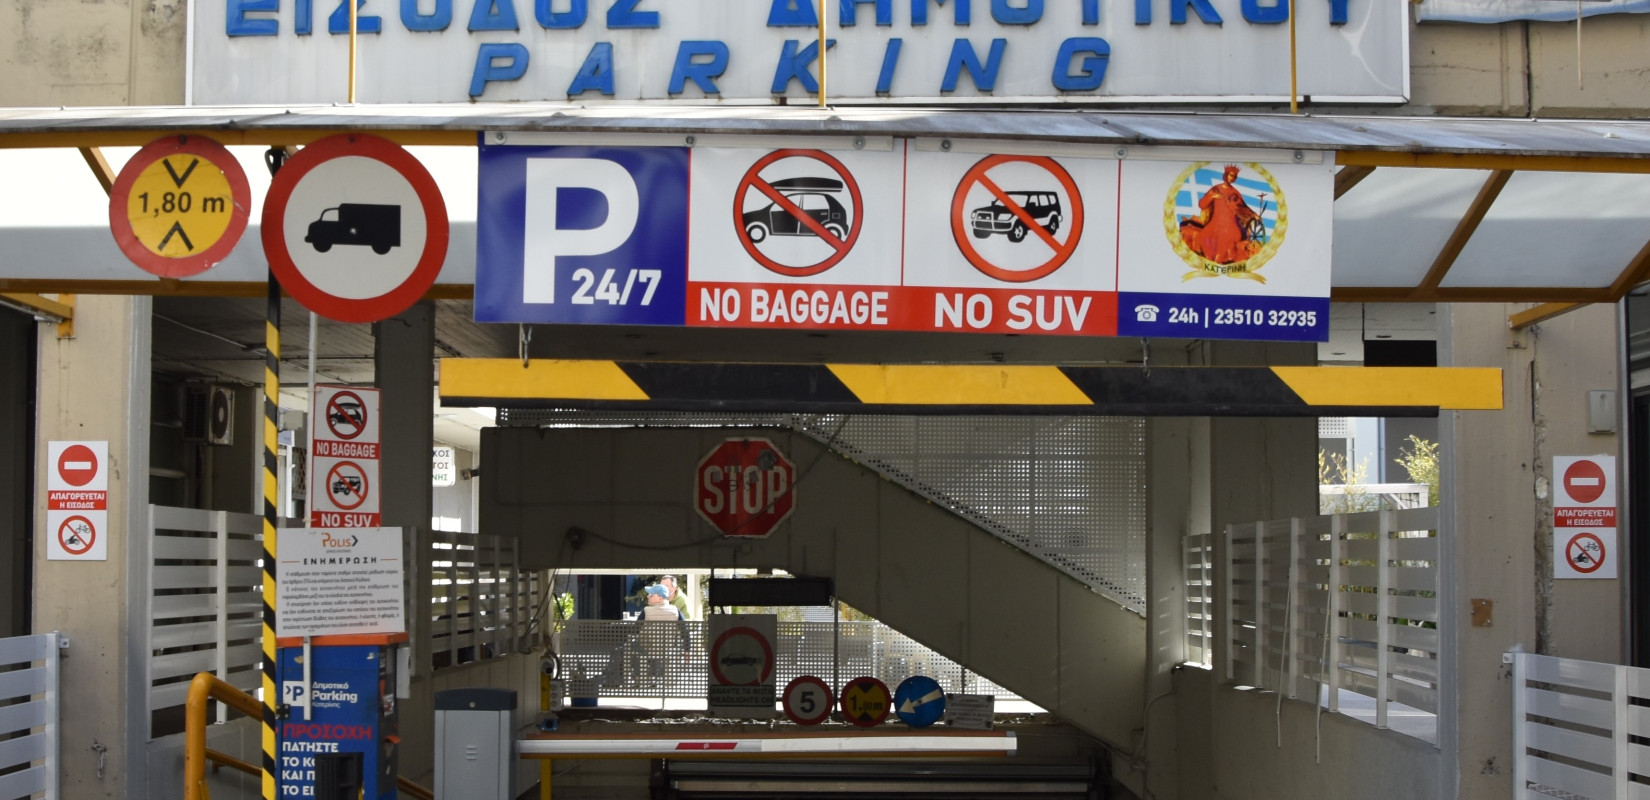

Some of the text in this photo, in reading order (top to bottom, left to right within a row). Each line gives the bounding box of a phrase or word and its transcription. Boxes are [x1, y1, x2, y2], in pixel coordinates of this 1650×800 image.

[469, 37, 1111, 98] PARKING
[138, 192, 226, 218] 1,80 m
[523, 157, 640, 304] P
[571, 268, 662, 307] 24/7
[700, 287, 889, 326] NO BAGGAGE
[934, 292, 1092, 332] NO SUV
[1168, 307, 1199, 324] 24h
[1214, 308, 1264, 326] 23510
[1268, 310, 1317, 328] 32935
[316, 441, 376, 458] NO BAGGAGE
[50, 492, 105, 501] ΑΠΑΓΟΡΕΥΕΤΑΙ
[703, 465, 787, 515] STOP
[321, 513, 373, 528] NO SUV
[1557, 509, 1614, 517] ΑΠΑΓΟΡΕΥΕΤΑΙ
[1574, 518, 1604, 526] ΕΙΣΟΔΟΣ
[303, 556, 377, 566] ΕΝΗΜΕΡΩΣΗ
[311, 681, 349, 690] Δημοτικό
[311, 690, 358, 704] Parking
[800, 691, 815, 713] 5
[283, 723, 373, 741] ΠΡΟΣΟΧΗ
[282, 741, 339, 753] ΠΑΤΗΣΤΕ
[282, 756, 300, 767] ΤΟ
[281, 770, 303, 780] ΚΑΙ
[281, 785, 300, 796] ΤΟ
